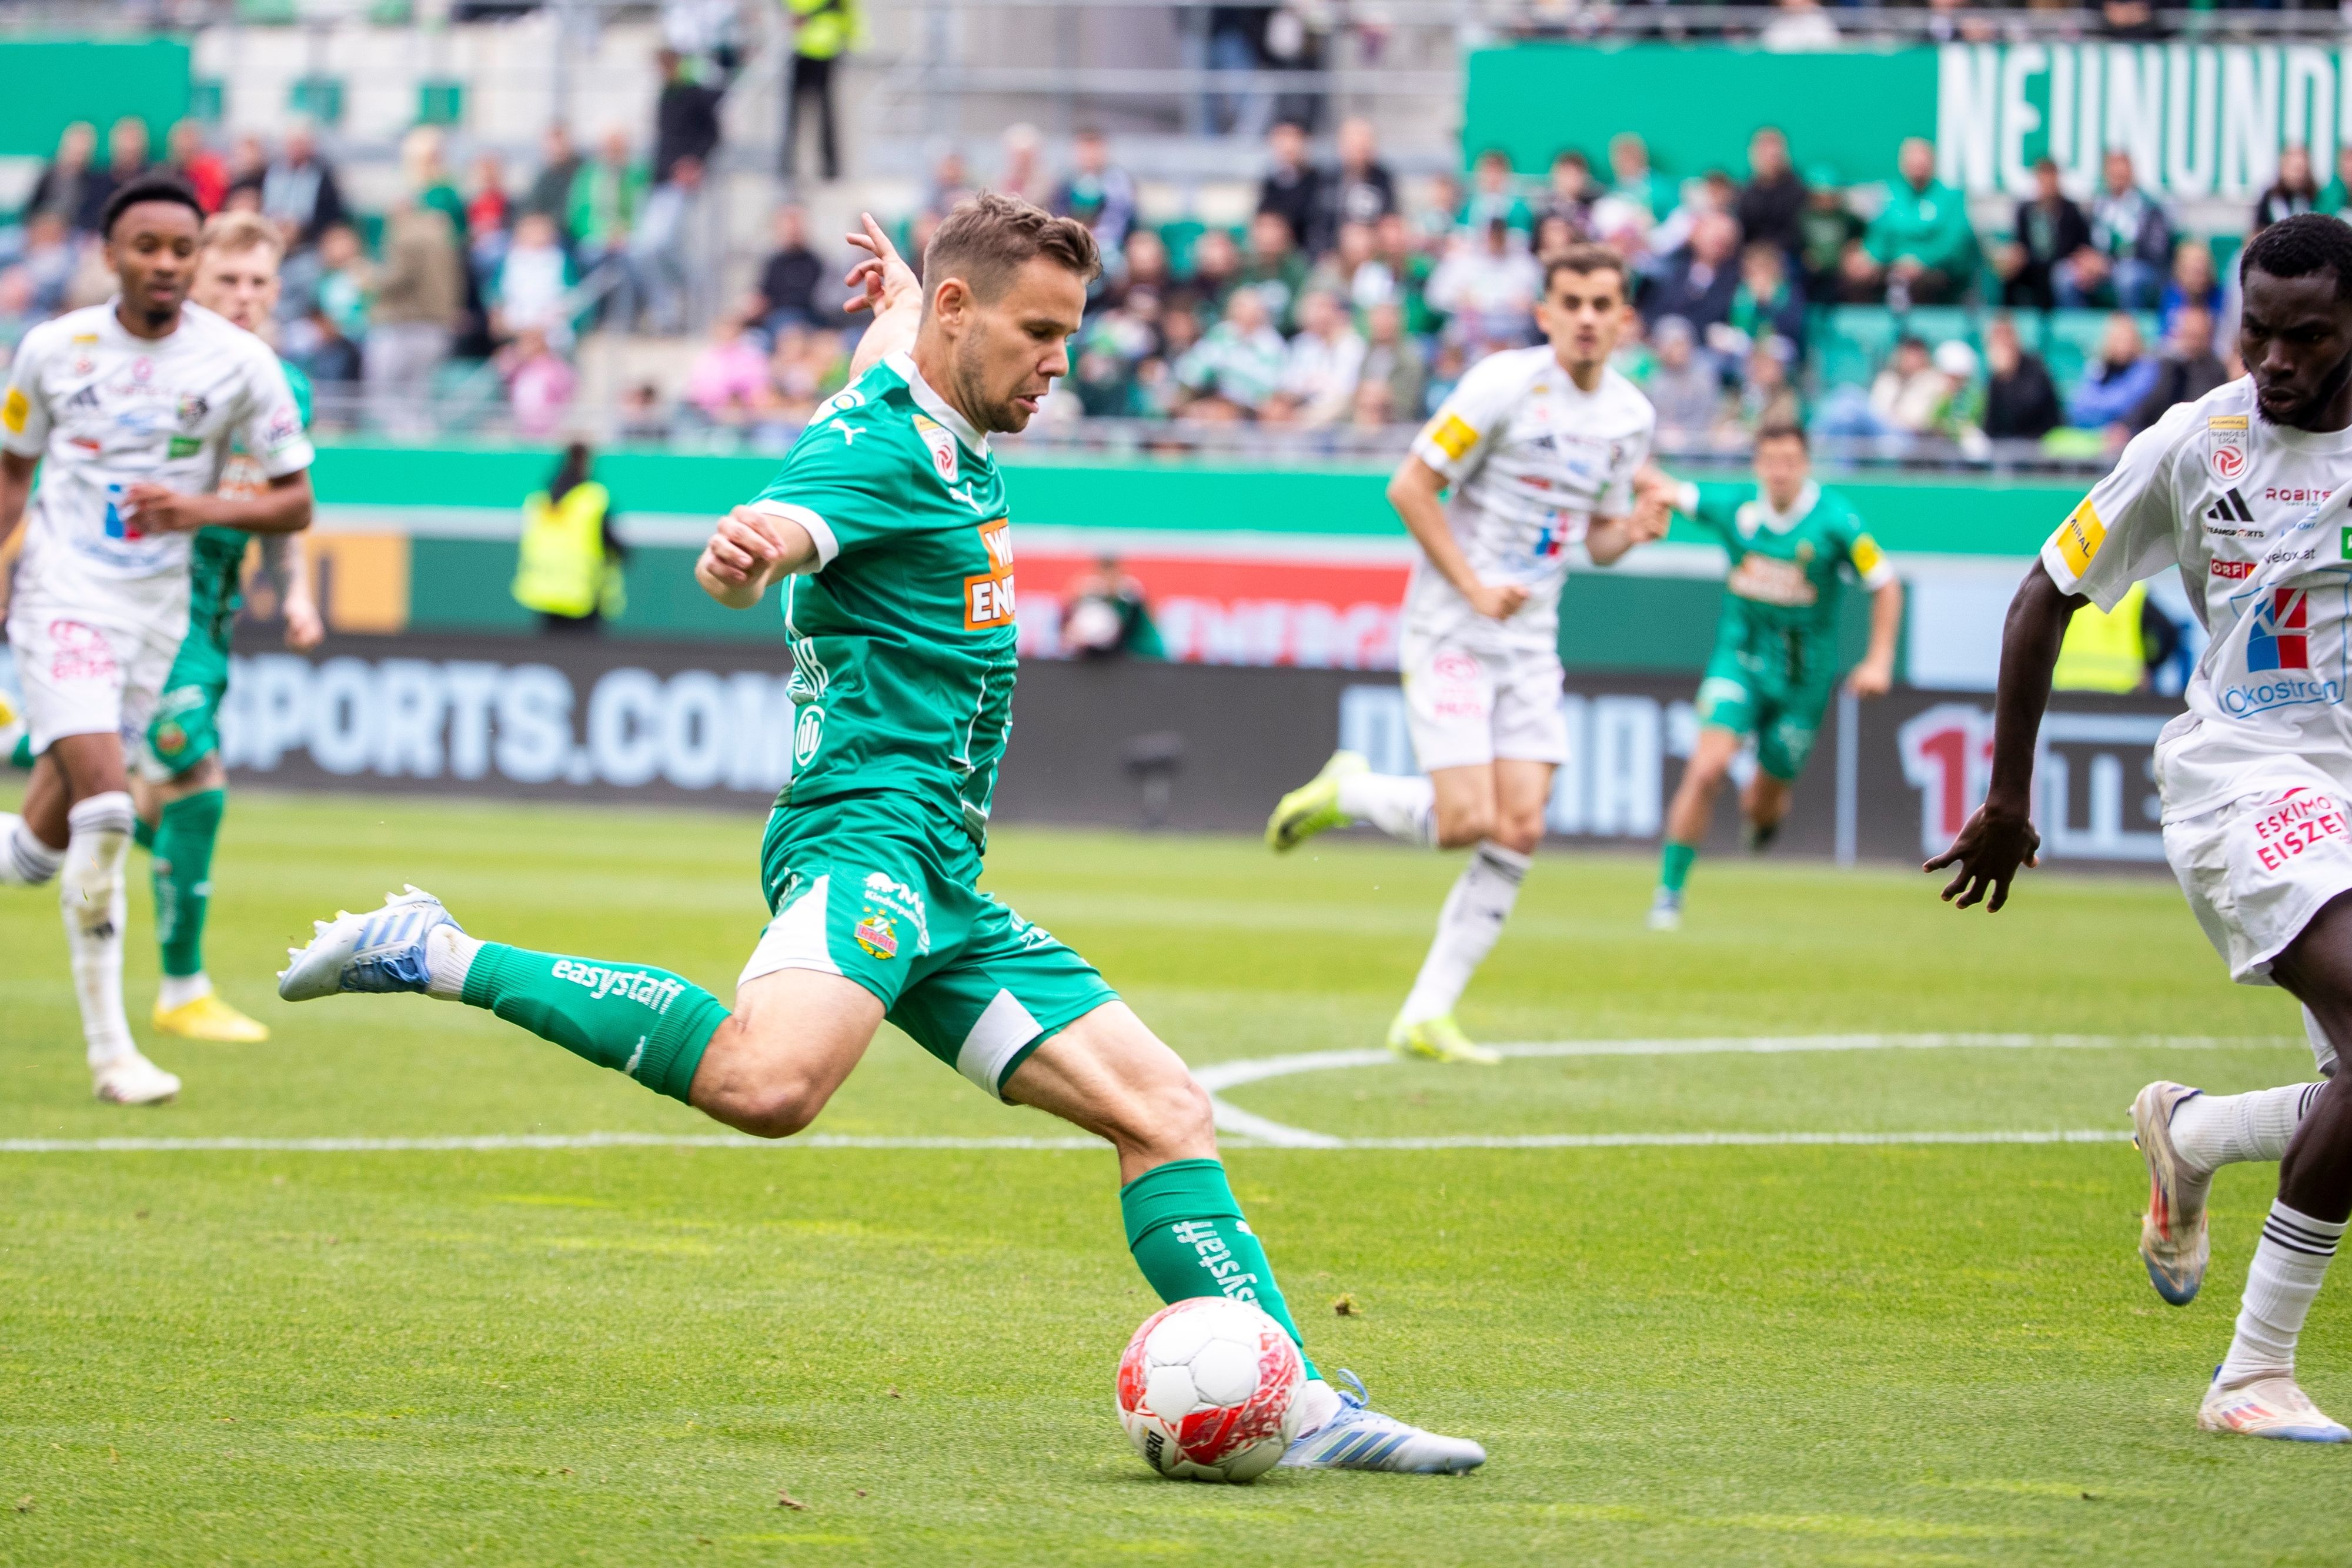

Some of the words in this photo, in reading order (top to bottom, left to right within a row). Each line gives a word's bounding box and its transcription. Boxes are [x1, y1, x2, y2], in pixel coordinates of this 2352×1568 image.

[2212, 562, 2242, 576] ORF
[2255, 796, 2332, 840] ESKIMO
[551, 959, 686, 1015] easystaff
